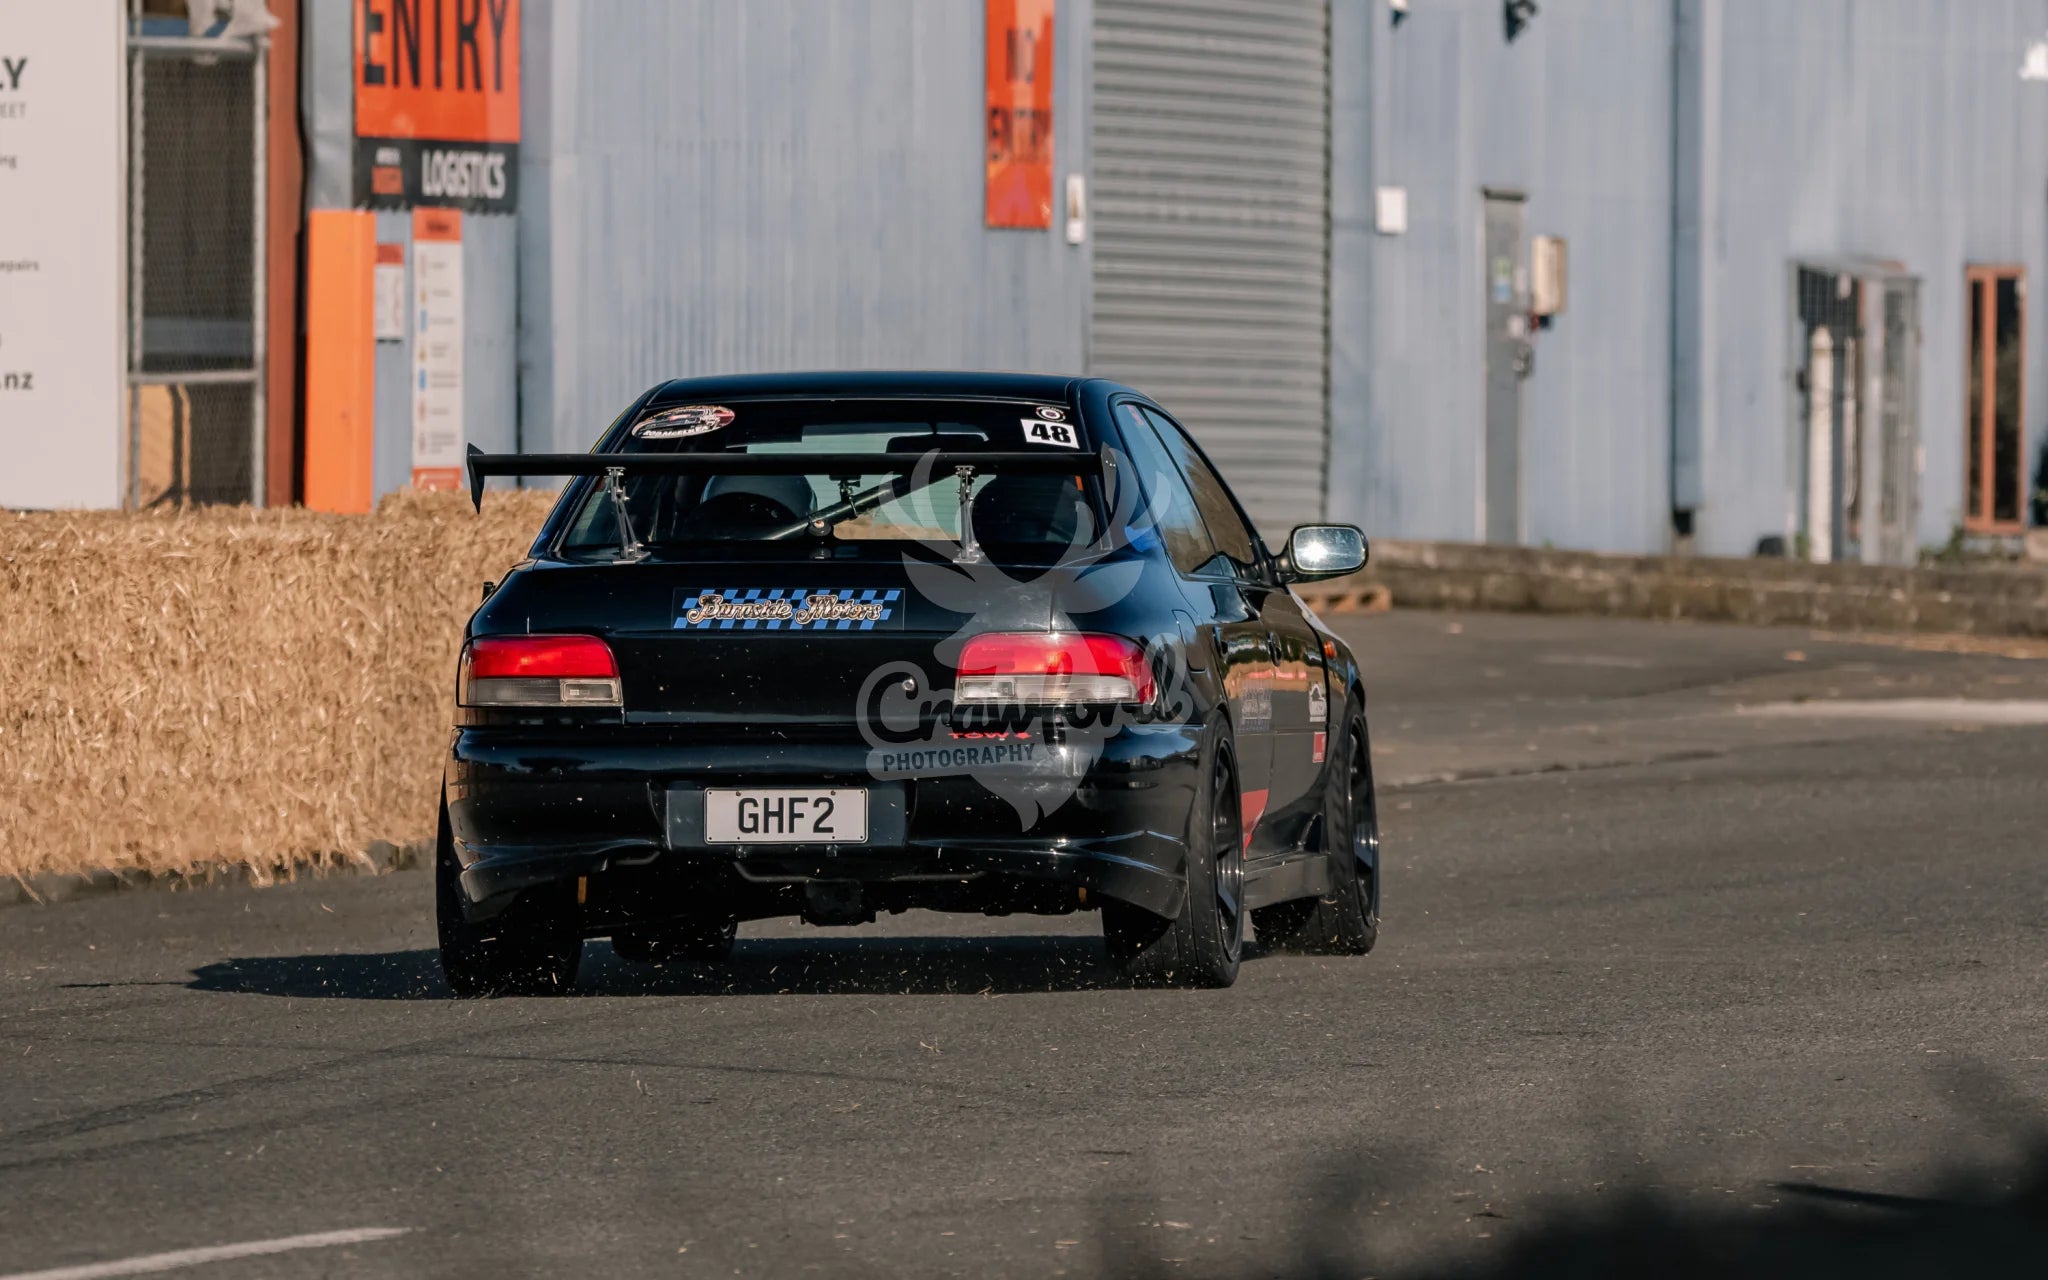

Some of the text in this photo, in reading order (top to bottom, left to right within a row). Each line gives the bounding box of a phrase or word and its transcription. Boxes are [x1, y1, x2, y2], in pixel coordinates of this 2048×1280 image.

[421, 150, 506, 199] LOGISTICS
[1030, 423, 1072, 444] 48
[687, 594, 883, 624] Burnside Motors
[948, 731, 1010, 740] TOW
[738, 797, 834, 834] GHF2
